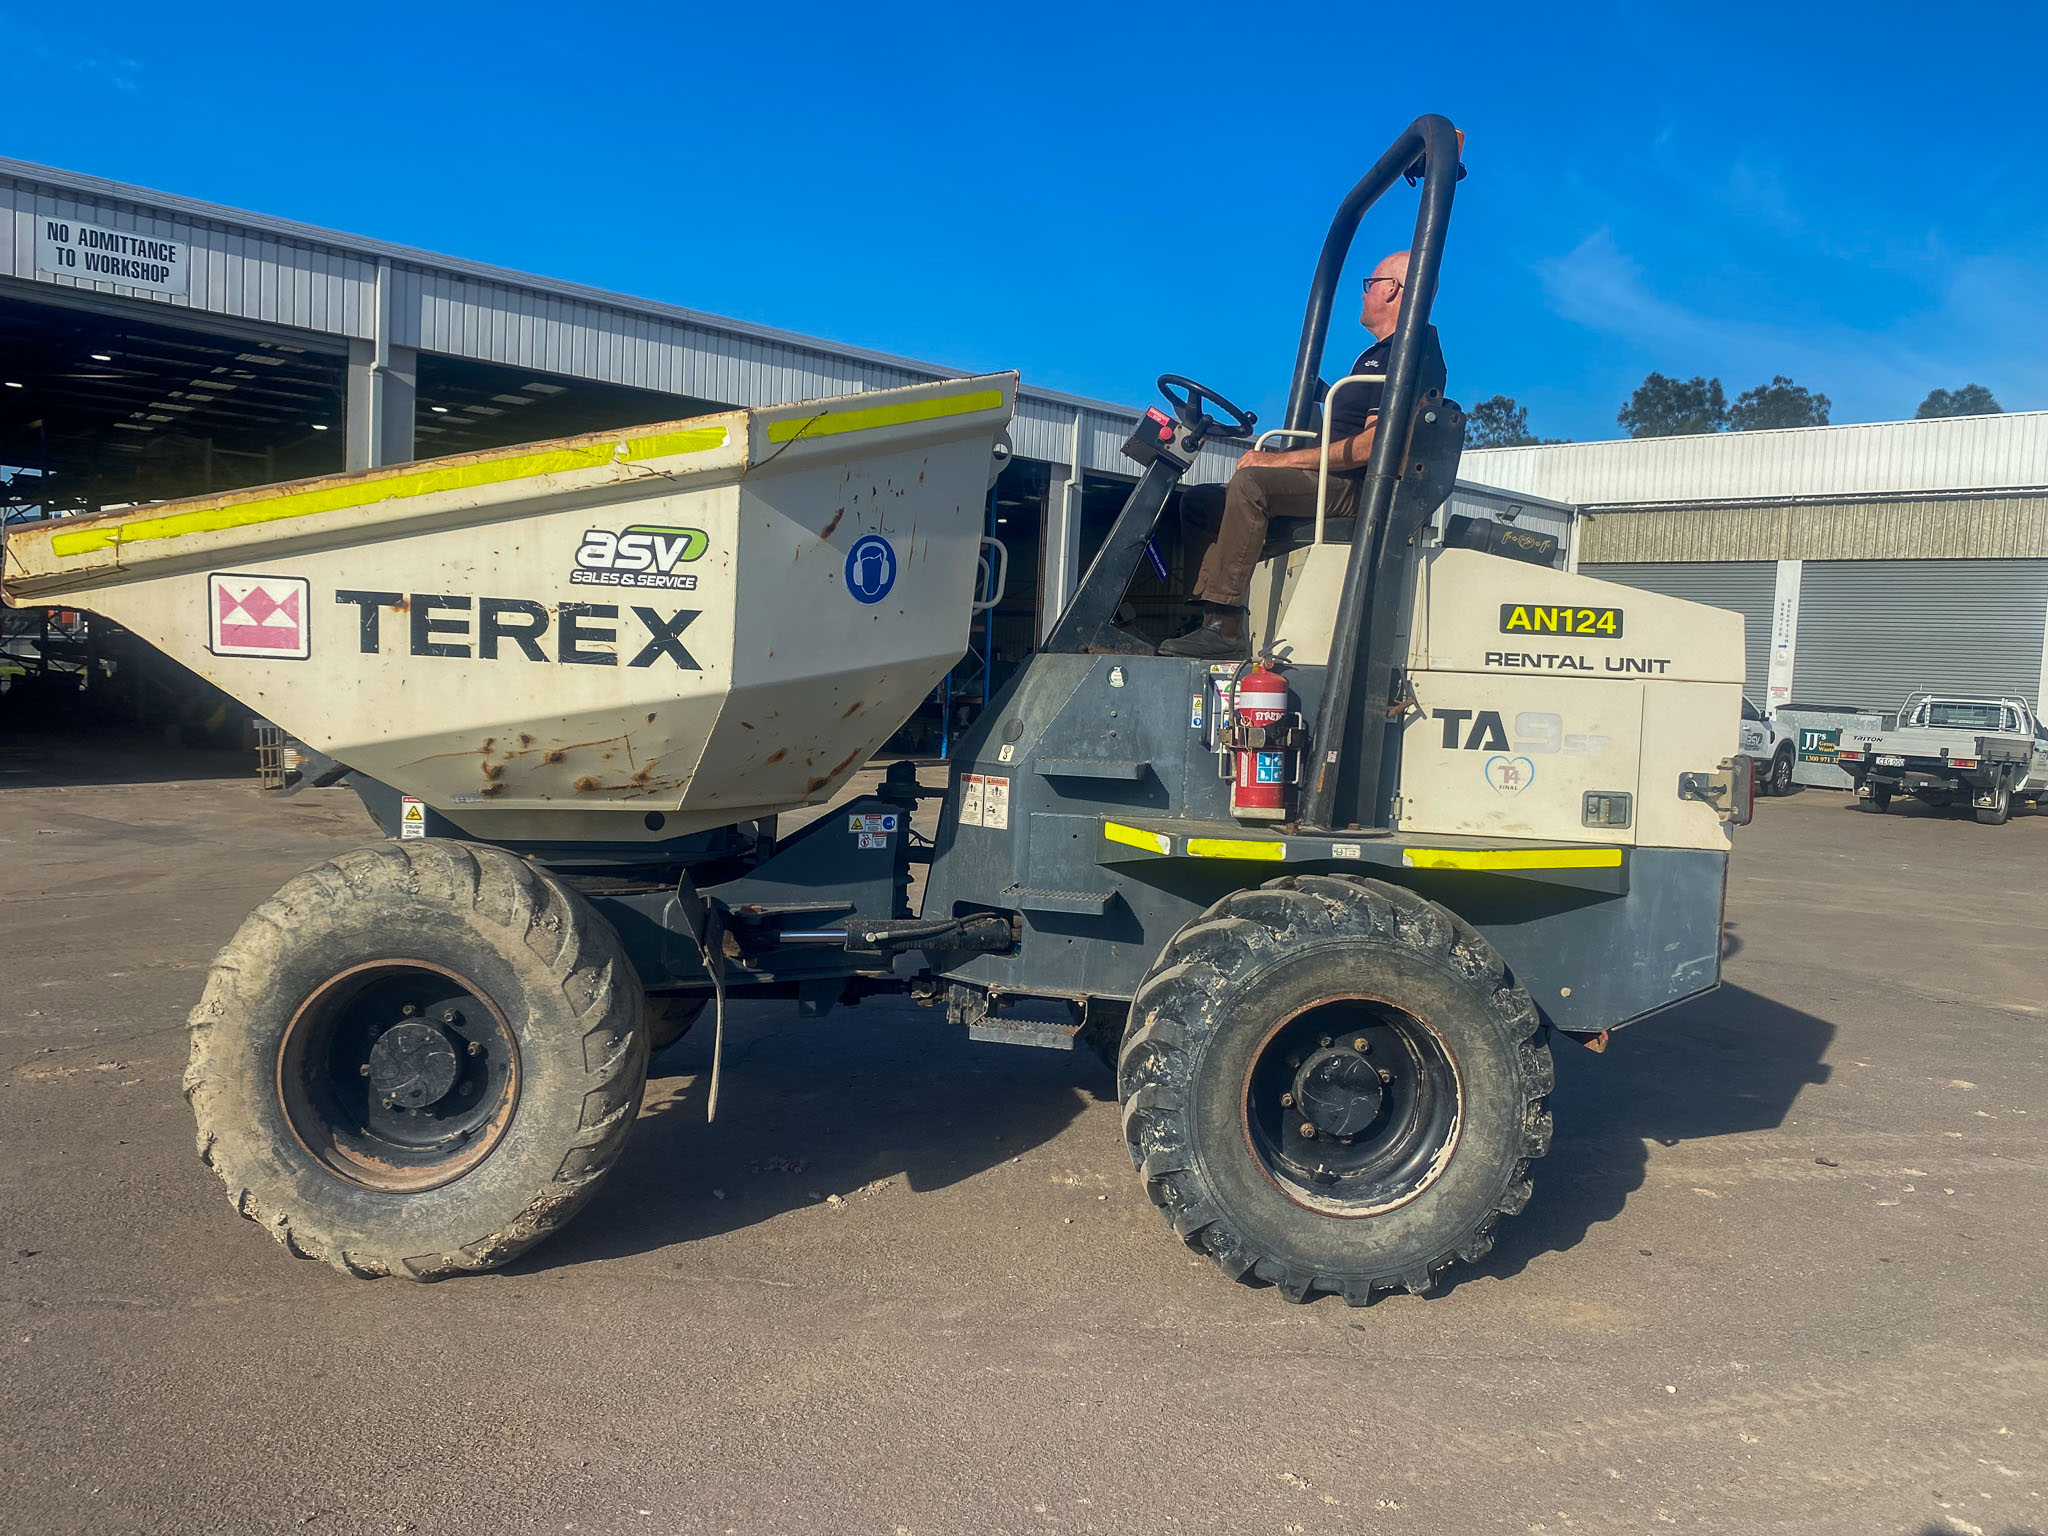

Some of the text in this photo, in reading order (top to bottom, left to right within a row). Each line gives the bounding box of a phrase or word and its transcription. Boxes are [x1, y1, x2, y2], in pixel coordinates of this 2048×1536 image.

[47, 221, 176, 263] NO ADMITTANCE
[56, 247, 170, 284] TO WORKSHOP
[621, 573, 636, 586] &
[637, 575, 696, 589] SERVICE
[335, 590, 704, 671] TEREX
[1506, 606, 1617, 634] AN124
[1485, 652, 1671, 674] RENTAL UNIT
[1853, 735, 1883, 743] TRITON
[1805, 755, 1819, 763] 1300
[1820, 756, 1830, 764] 971
